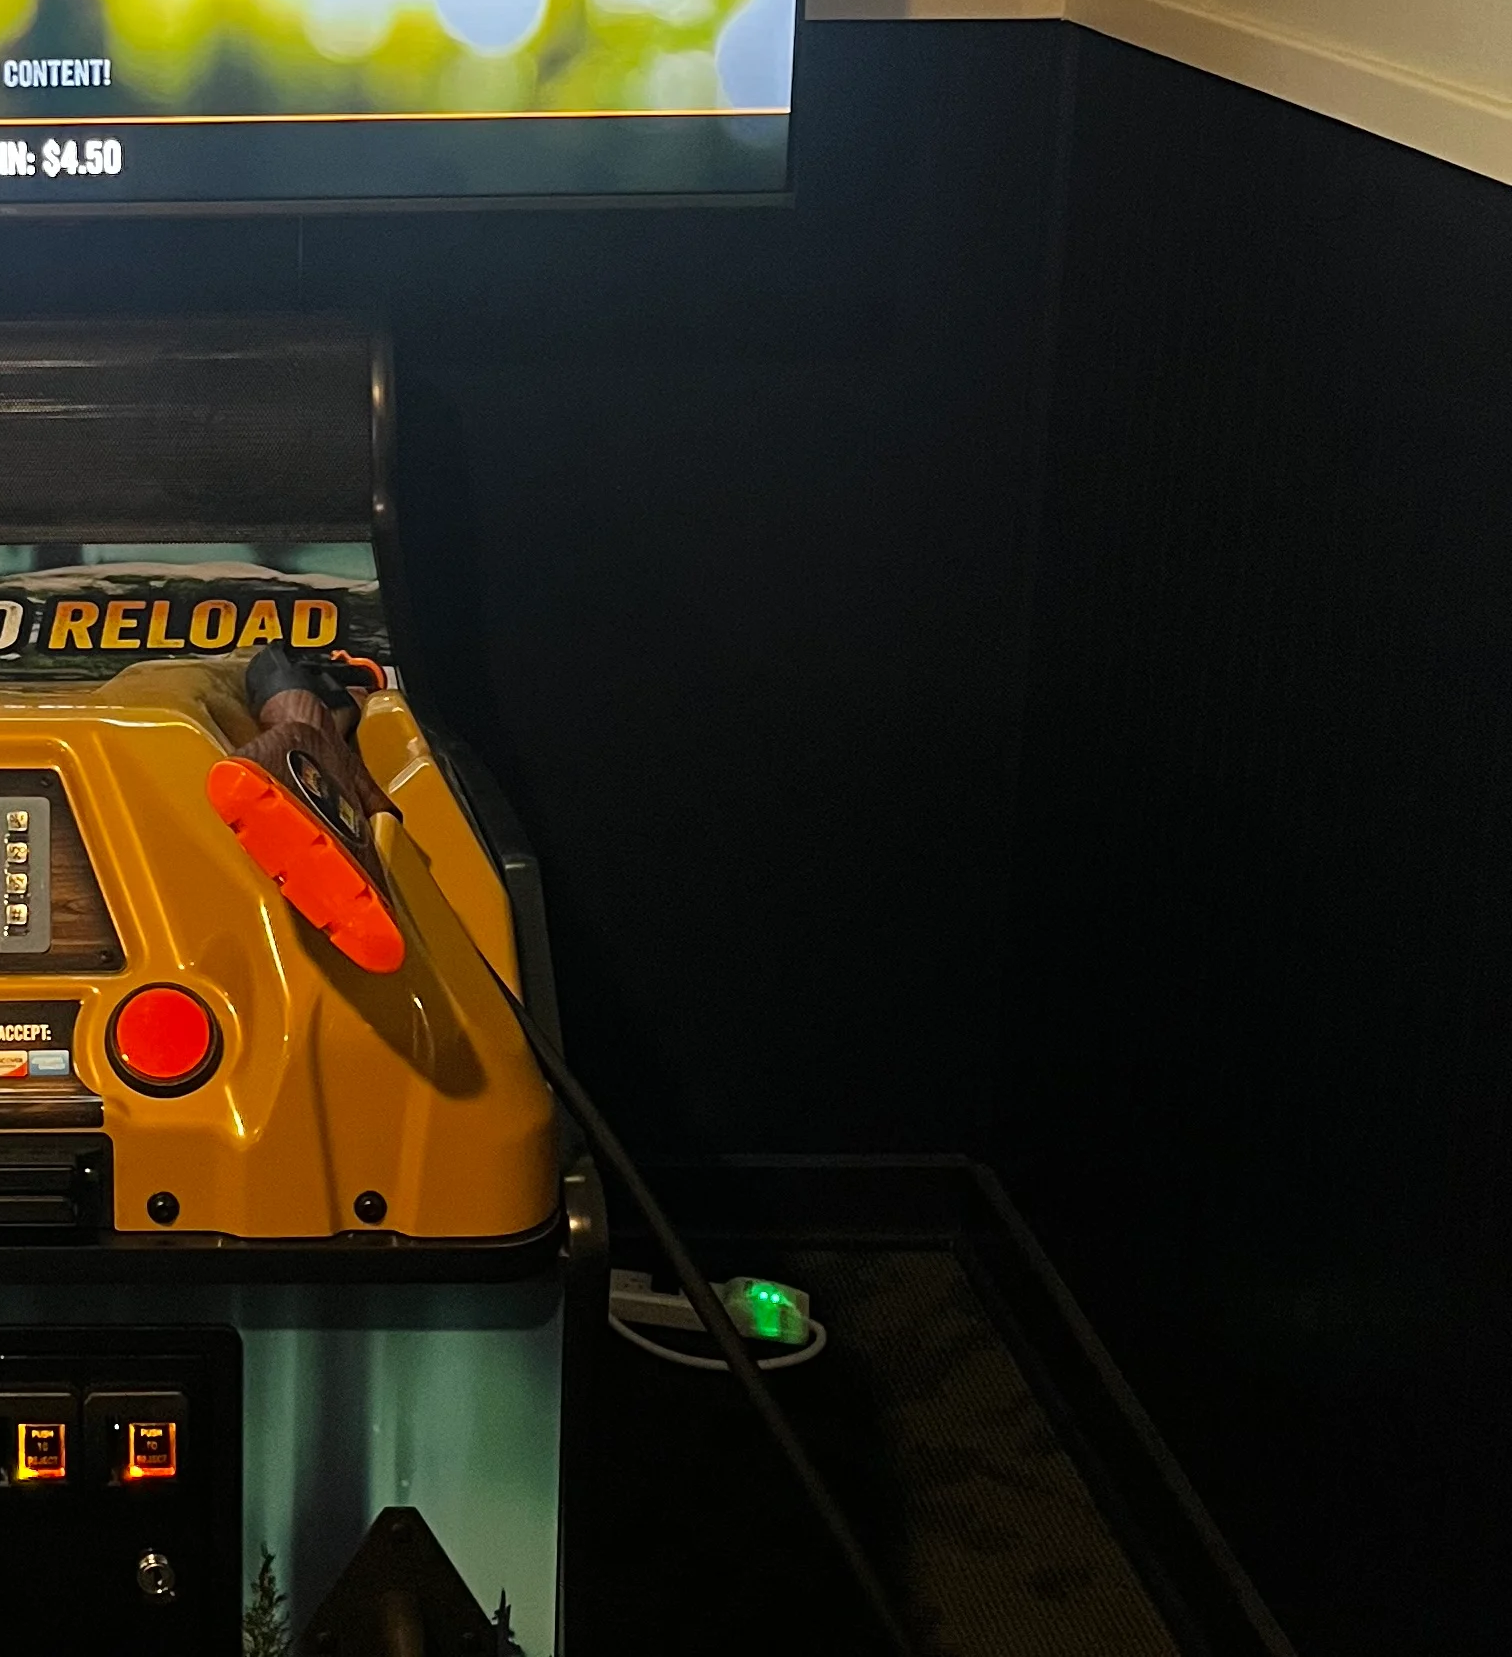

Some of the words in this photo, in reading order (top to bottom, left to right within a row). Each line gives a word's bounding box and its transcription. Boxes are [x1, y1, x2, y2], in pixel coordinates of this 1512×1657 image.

[3, 58, 111, 88] CONTENT!
[41, 138, 123, 178] $4.50
[47, 599, 339, 649] RELOAD
